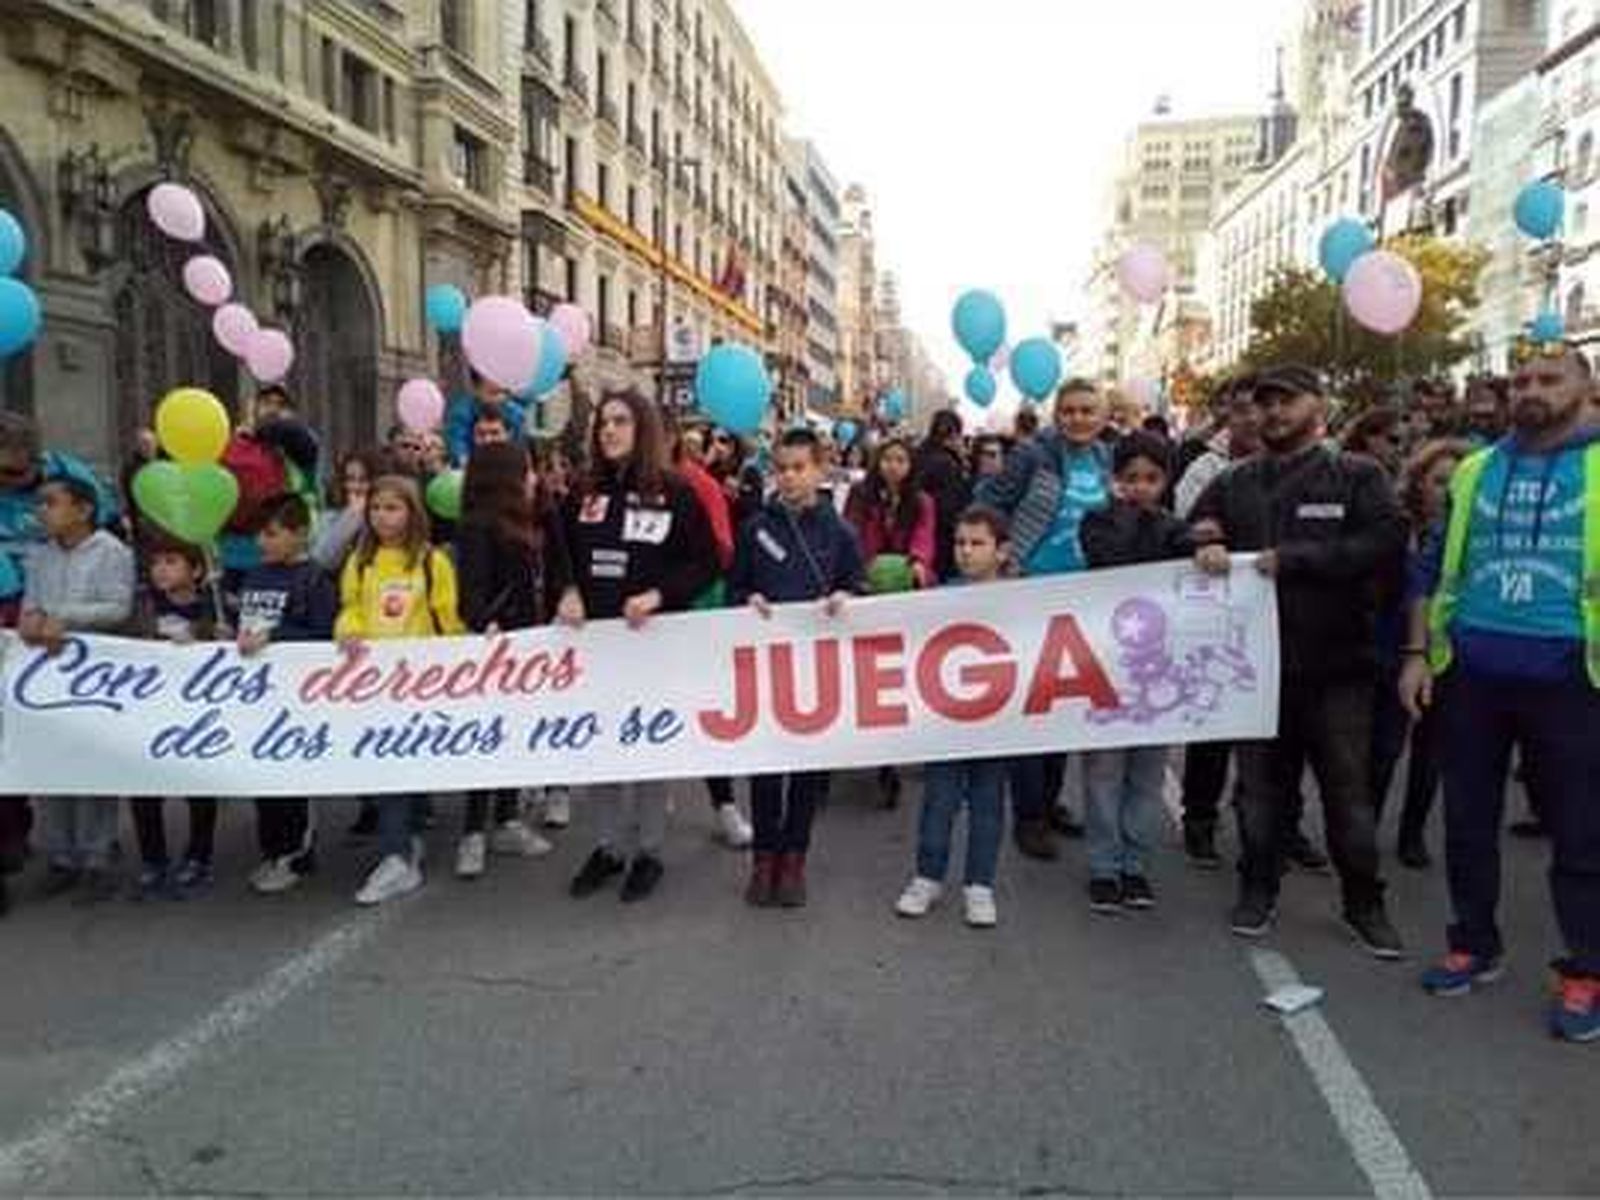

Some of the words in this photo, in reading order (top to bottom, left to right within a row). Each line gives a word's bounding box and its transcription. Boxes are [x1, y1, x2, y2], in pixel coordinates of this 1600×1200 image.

[14, 637, 163, 710] Con
[181, 648, 271, 702] los
[299, 638, 580, 704] derechos
[699, 613, 1121, 743] JUEGA
[151, 708, 233, 758] de
[252, 708, 331, 760] los
[352, 711, 502, 758] niños
[528, 712, 603, 750] no
[619, 706, 683, 744] se
